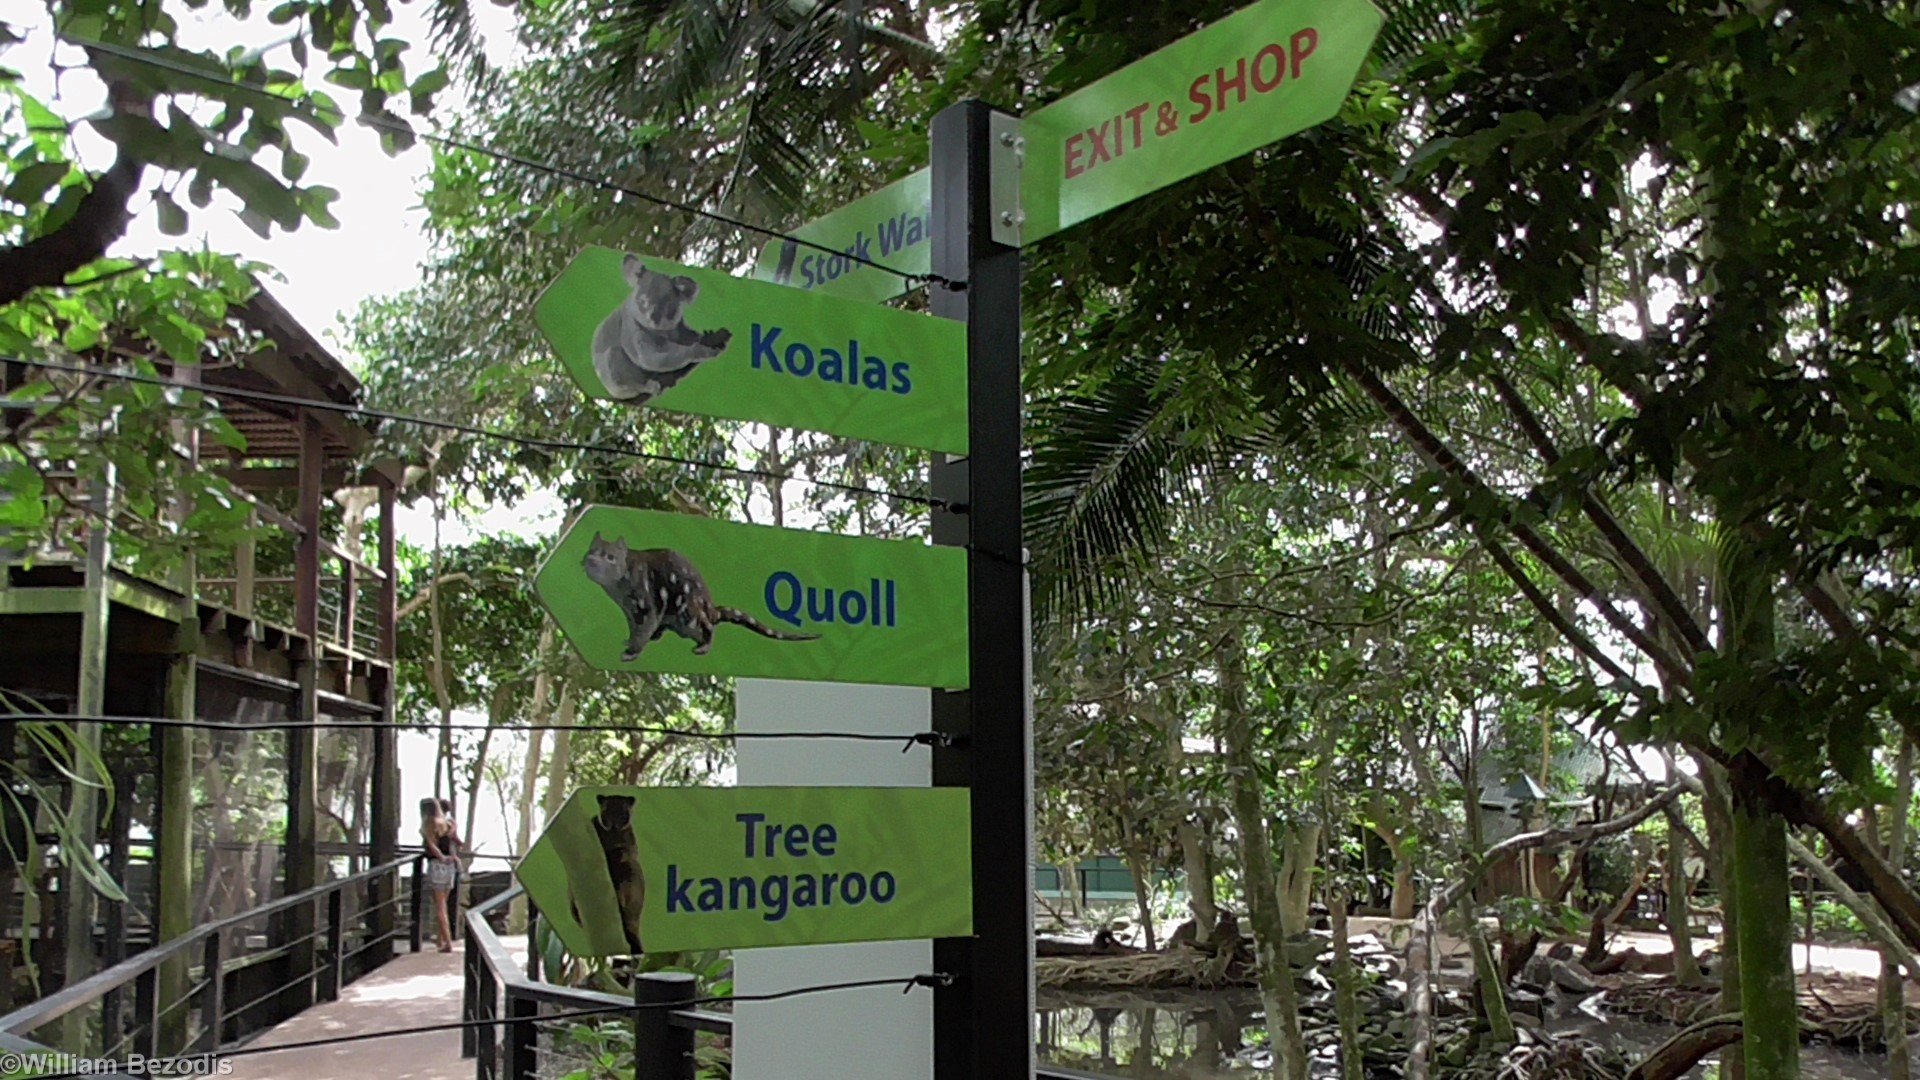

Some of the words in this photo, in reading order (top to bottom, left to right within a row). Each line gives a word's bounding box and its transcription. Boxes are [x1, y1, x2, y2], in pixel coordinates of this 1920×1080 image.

[1064, 102, 1149, 180] EXIT
[1154, 101, 1178, 137] &
[1189, 27, 1318, 124] SHOP
[800, 231, 872, 289] Stork
[751, 323, 912, 395] Koalas
[764, 571, 896, 628] Quoll
[735, 813, 837, 858] Tree
[666, 864, 896, 922] kangaroo
